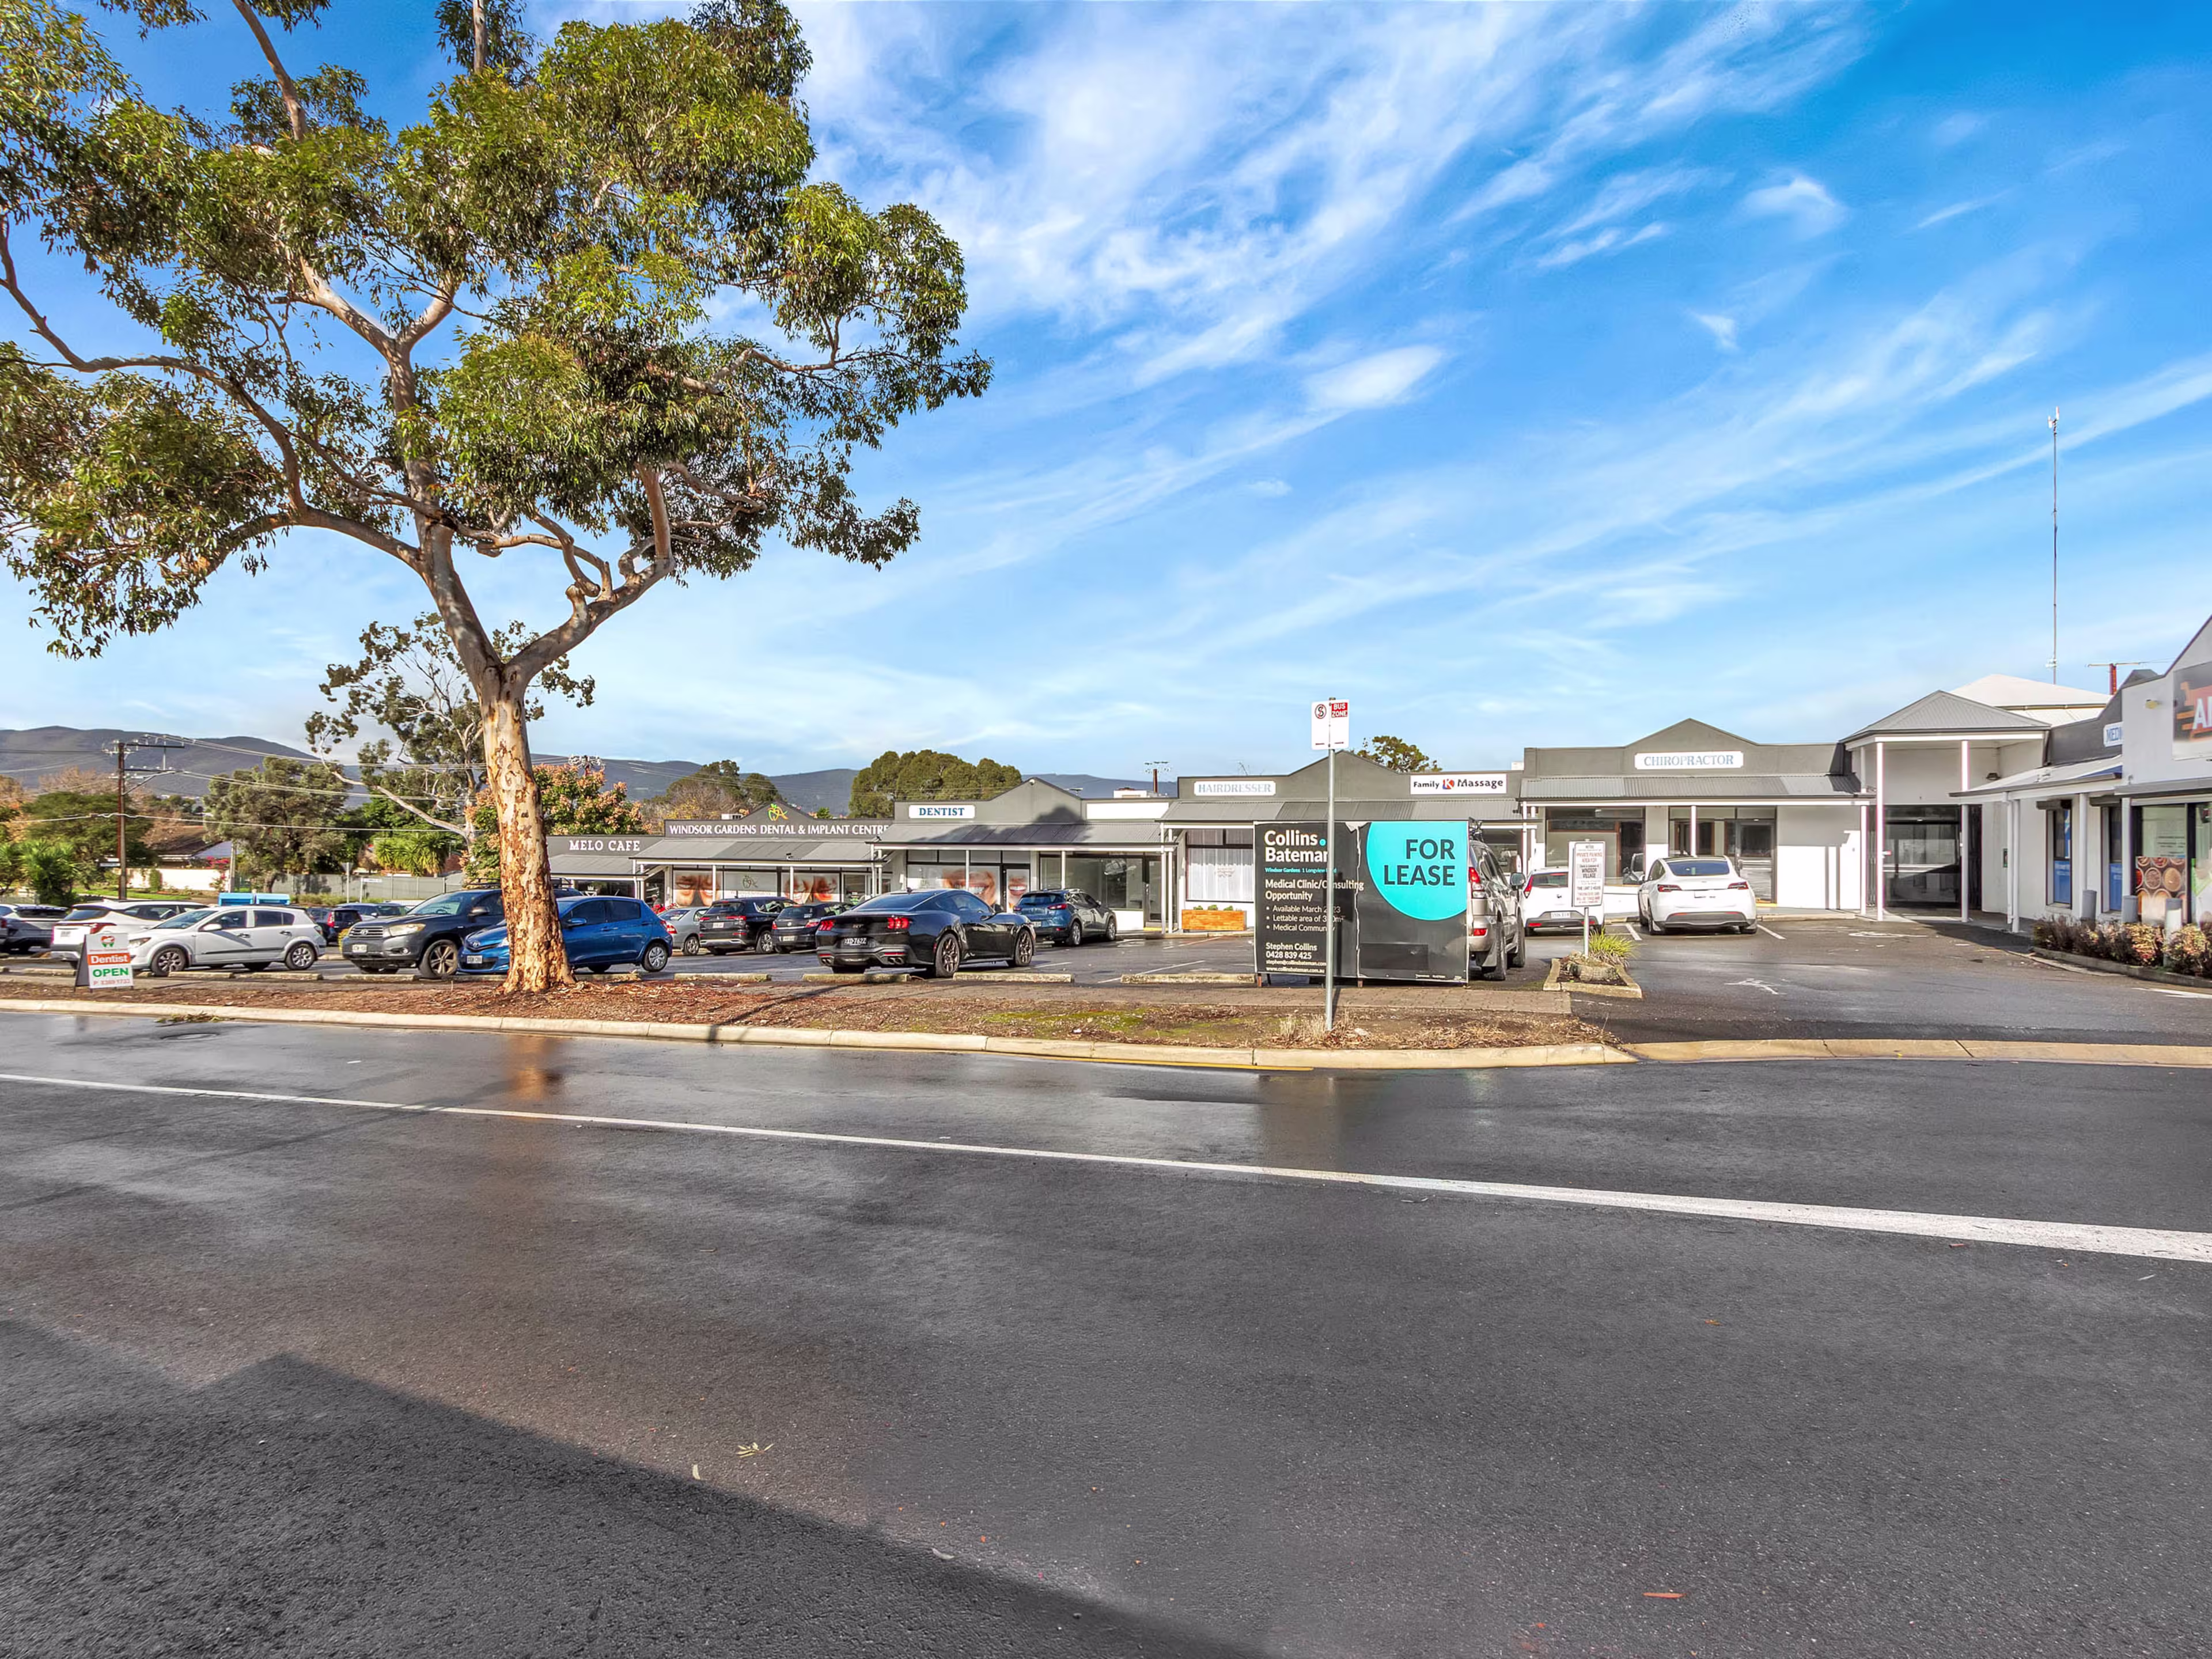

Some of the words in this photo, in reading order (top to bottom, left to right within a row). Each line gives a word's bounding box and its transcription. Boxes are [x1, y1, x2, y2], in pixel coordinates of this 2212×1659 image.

[1644, 755, 1733, 766] CHIROPRACTOR
[1198, 783, 1271, 793] HAIRDRESSER
[1413, 781, 1440, 790] Family
[1457, 779, 1503, 789] Massage
[918, 808, 965, 816] DENTIST
[669, 825, 712, 835] WINDSOR
[714, 824, 756, 835] GARDENS
[760, 824, 796, 835] DENTAL
[798, 825, 805, 835] &
[808, 825, 850, 835] IMPLANT
[569, 840, 604, 851] MELO
[608, 840, 641, 851] CAFE
[1406, 839, 1455, 859] FOR
[1384, 865, 1455, 885] LEASE
[1265, 879, 1296, 889] Medical
[1297, 879, 1364, 891] Clinic/Cnsulting
[1265, 891, 1313, 902] Opportunity
[1266, 942, 1294, 951] Stephen
[1294, 943, 1317, 951] Collins
[90, 955, 128, 964] Dentist
[1266, 950, 1283, 959] 0428
[1284, 951, 1297, 959] 839
[1298, 952, 1312, 960] 425
[92, 967, 129, 978] OPEN
